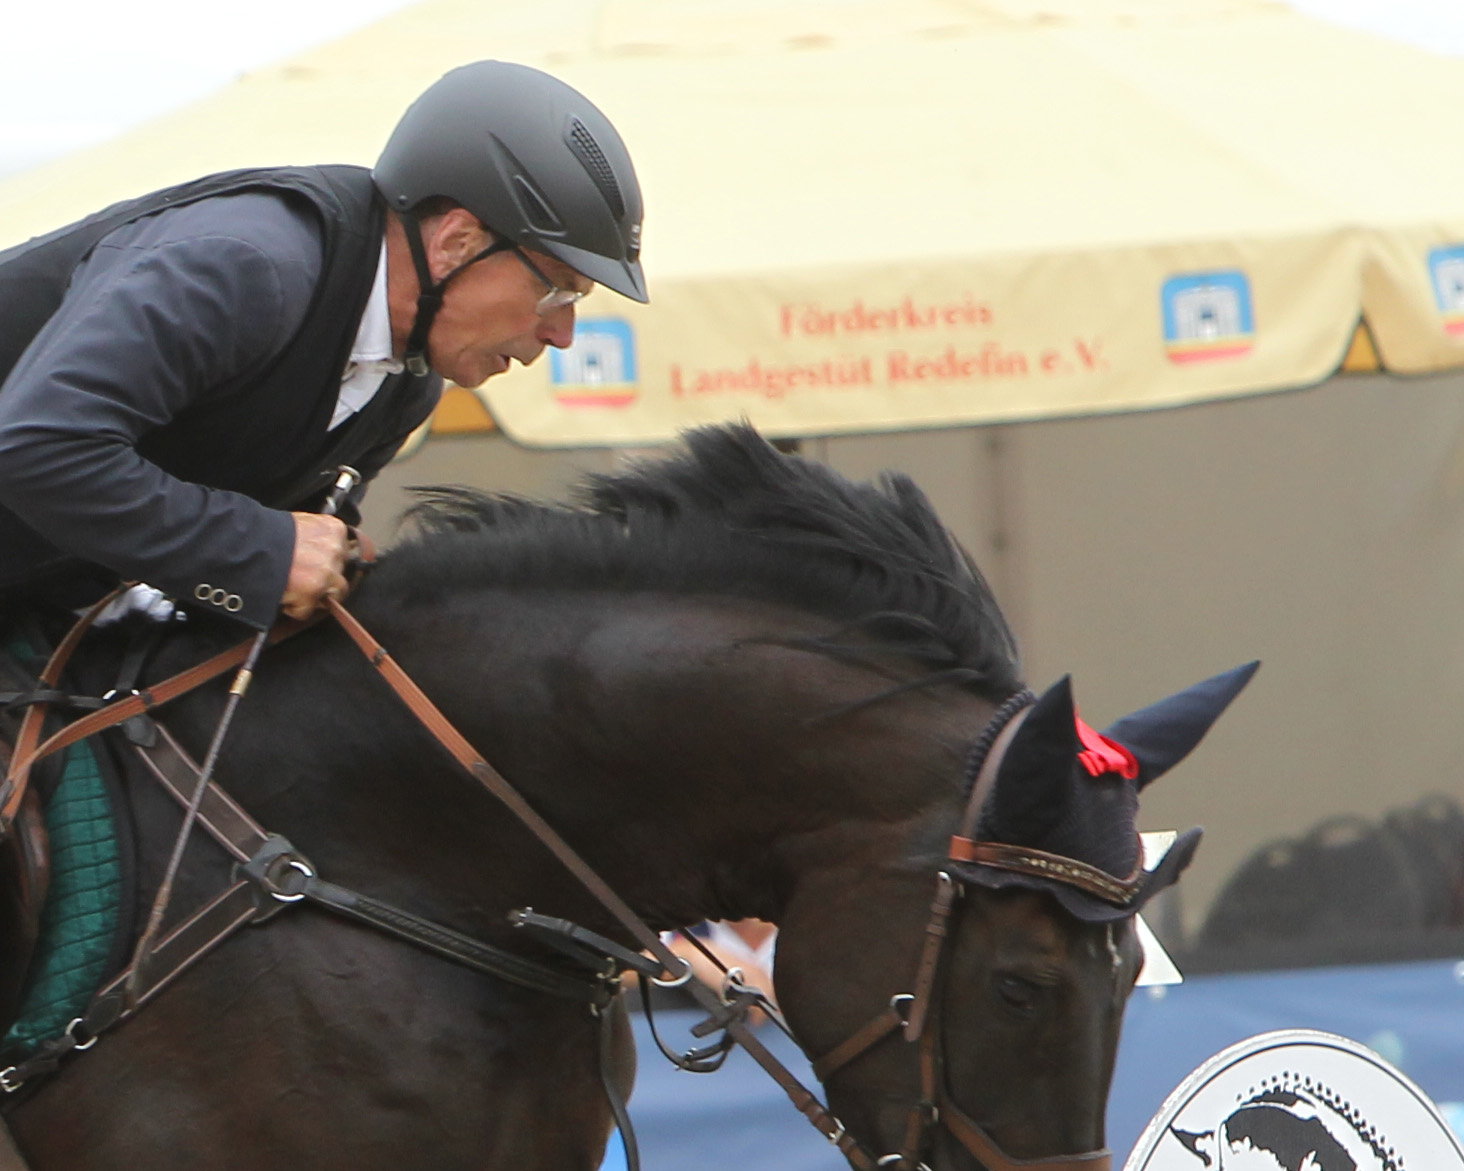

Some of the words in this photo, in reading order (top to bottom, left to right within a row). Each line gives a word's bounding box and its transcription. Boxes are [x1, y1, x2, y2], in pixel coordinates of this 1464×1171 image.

[781, 291, 994, 338] Förderkreis
[670, 353, 873, 400] Landgestüt
[887, 341, 1029, 384] Redefin
